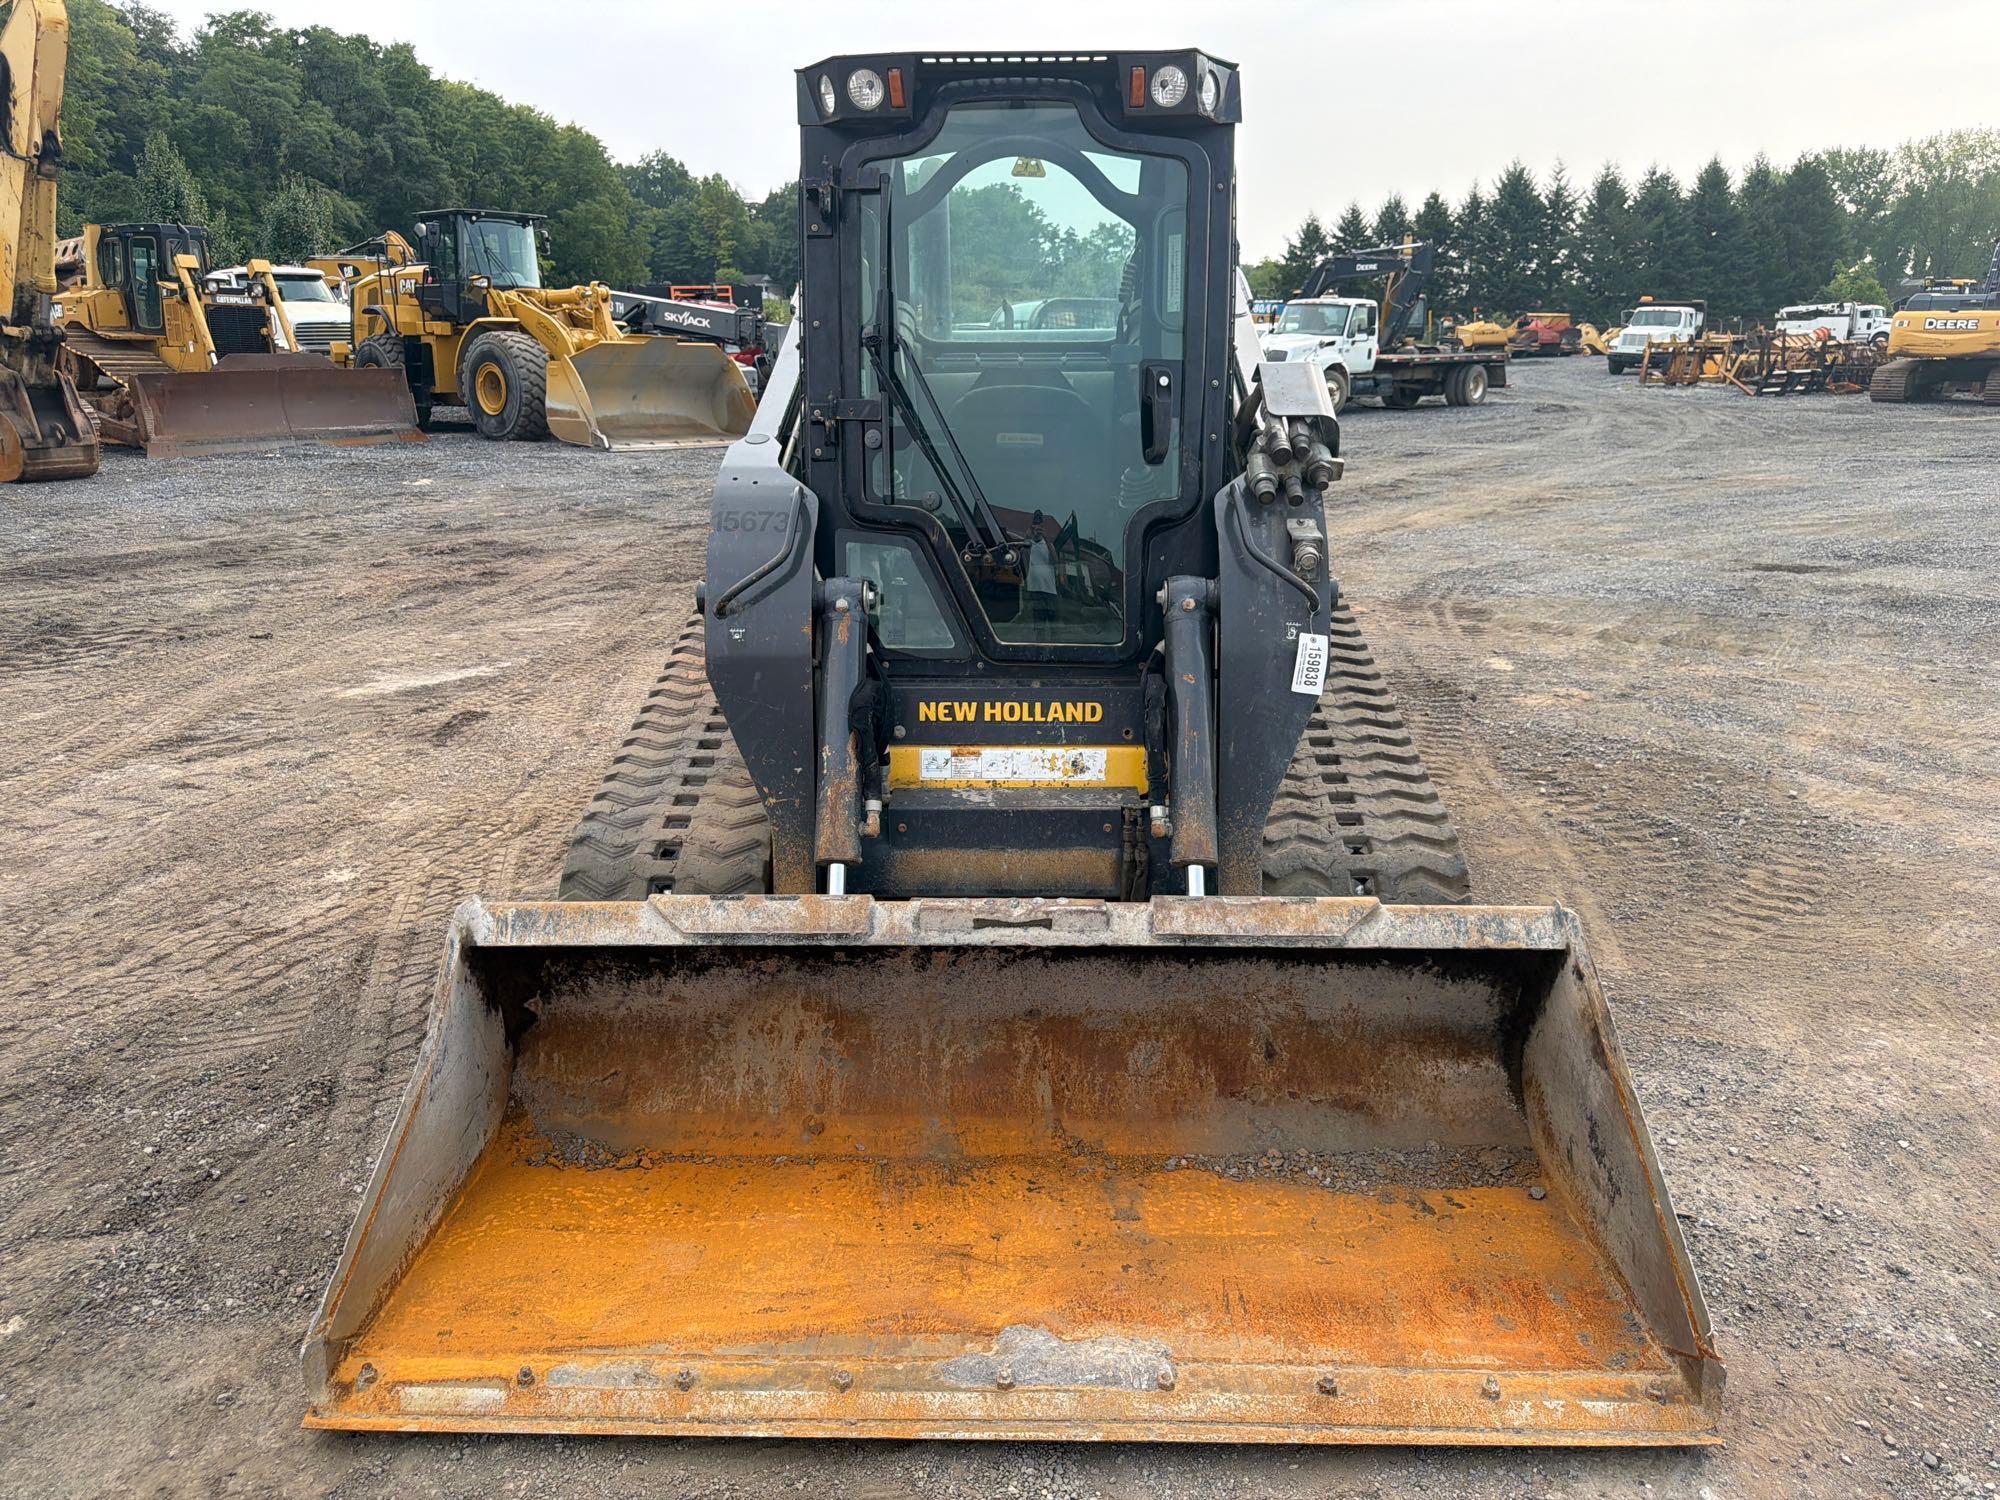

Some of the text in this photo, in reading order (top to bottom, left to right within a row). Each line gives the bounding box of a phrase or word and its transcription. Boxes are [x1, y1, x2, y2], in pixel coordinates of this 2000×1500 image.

[344, 265, 354, 277] CAT
[1356, 263, 1378, 271] DEERE
[400, 279, 416, 294] CAT
[216, 295, 252, 305] CATERPILLAR
[616, 303, 625, 314] TH
[664, 311, 711, 329] SKYJACK
[1924, 317, 1979, 330] DEERE
[1303, 646, 1322, 687] 159838
[918, 701, 1103, 723] NEW HOLLAND
